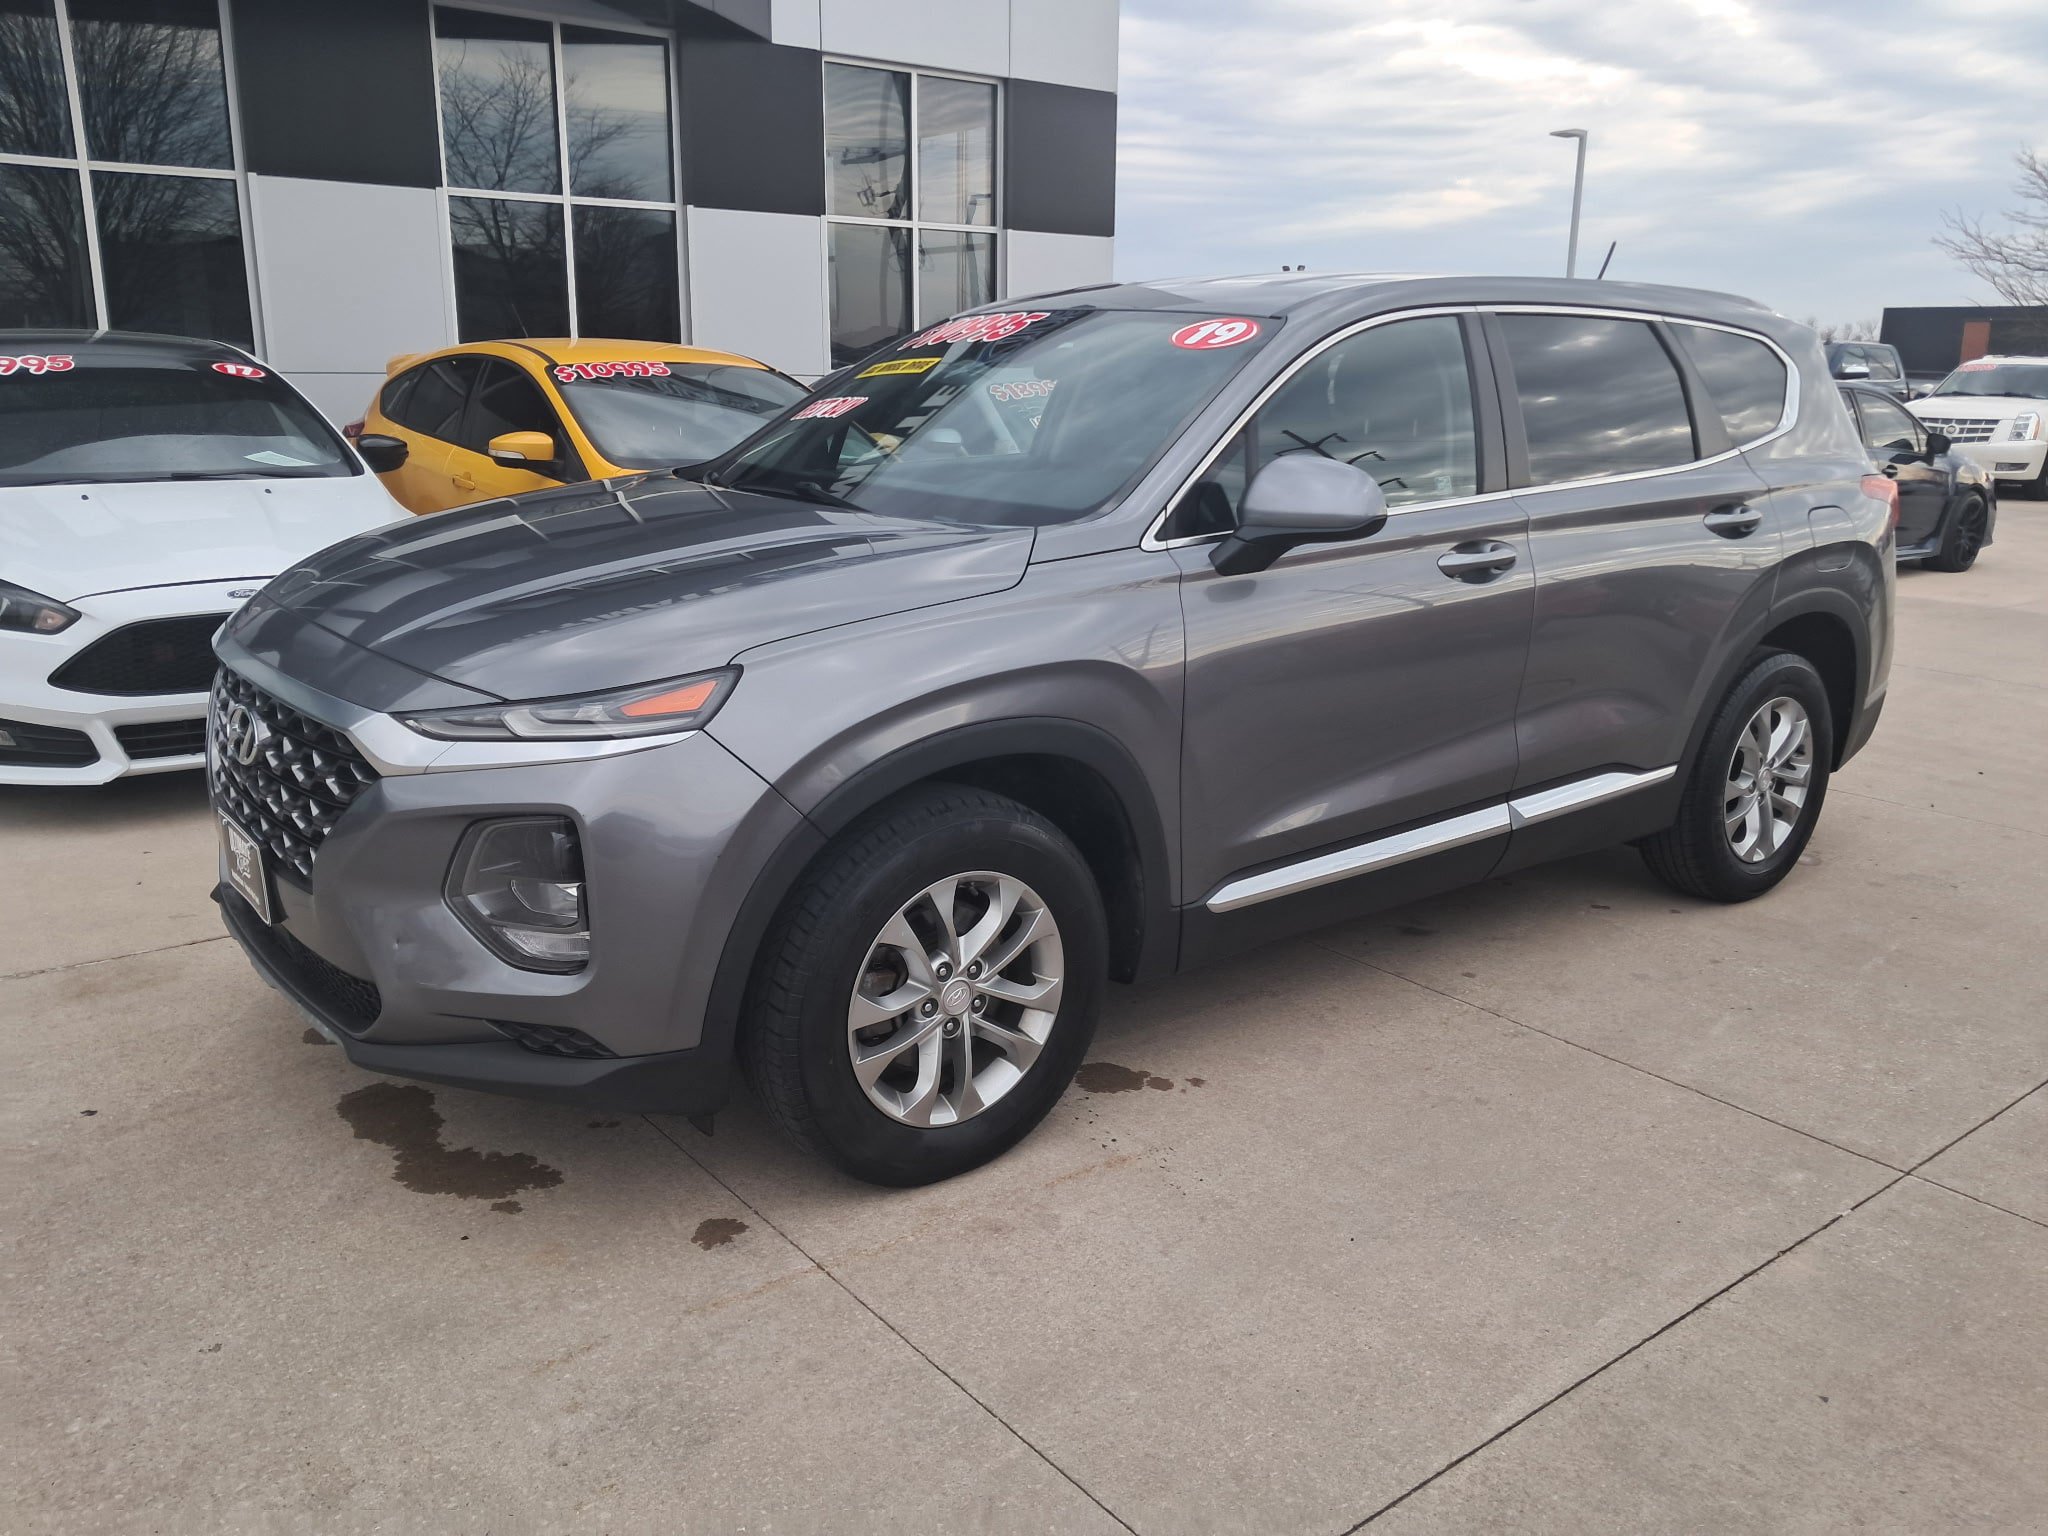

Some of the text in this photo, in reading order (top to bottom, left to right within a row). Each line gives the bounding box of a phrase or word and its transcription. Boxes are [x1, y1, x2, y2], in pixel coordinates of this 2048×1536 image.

[1183, 321, 1248, 345] 19
[223, 364, 253, 376] 17
[554, 361, 671, 383] $10995
